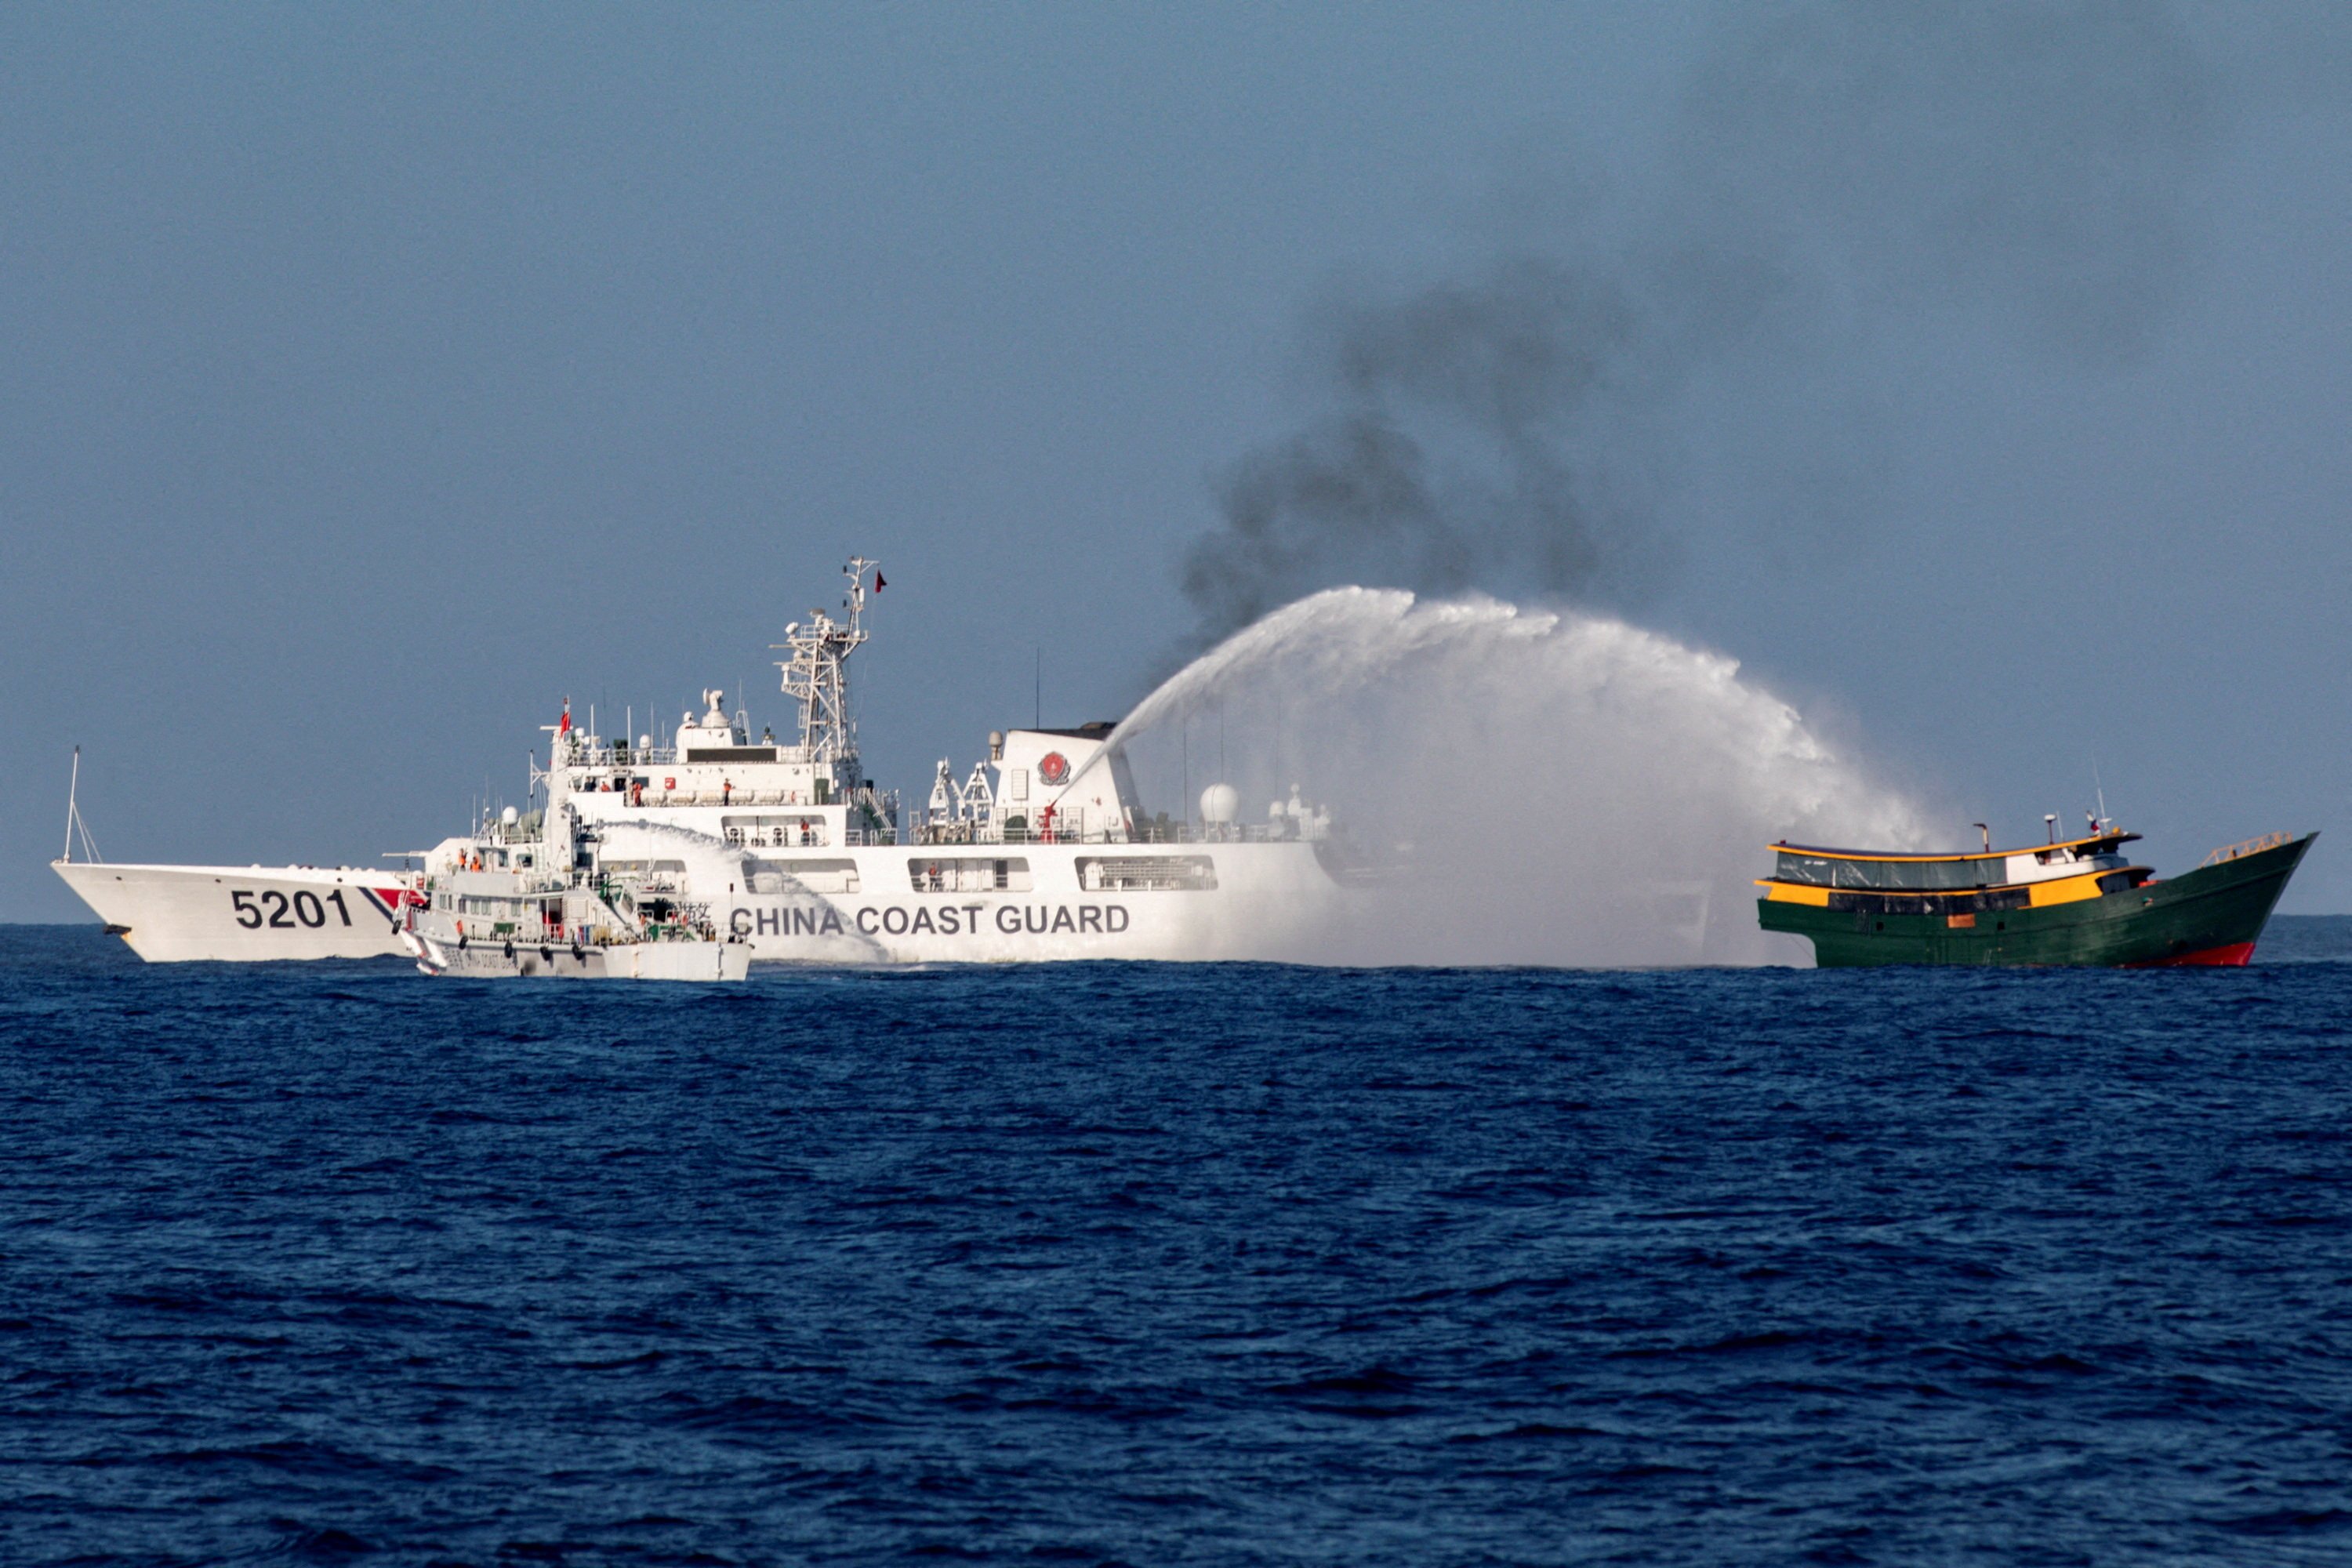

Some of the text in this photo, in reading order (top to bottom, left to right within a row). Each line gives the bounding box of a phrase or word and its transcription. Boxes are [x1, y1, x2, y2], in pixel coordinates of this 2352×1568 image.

[231, 889, 352, 929] 5201
[731, 908, 845, 936] CHINA
[856, 906, 983, 935] COAST
[996, 906, 1130, 934] GUARD
